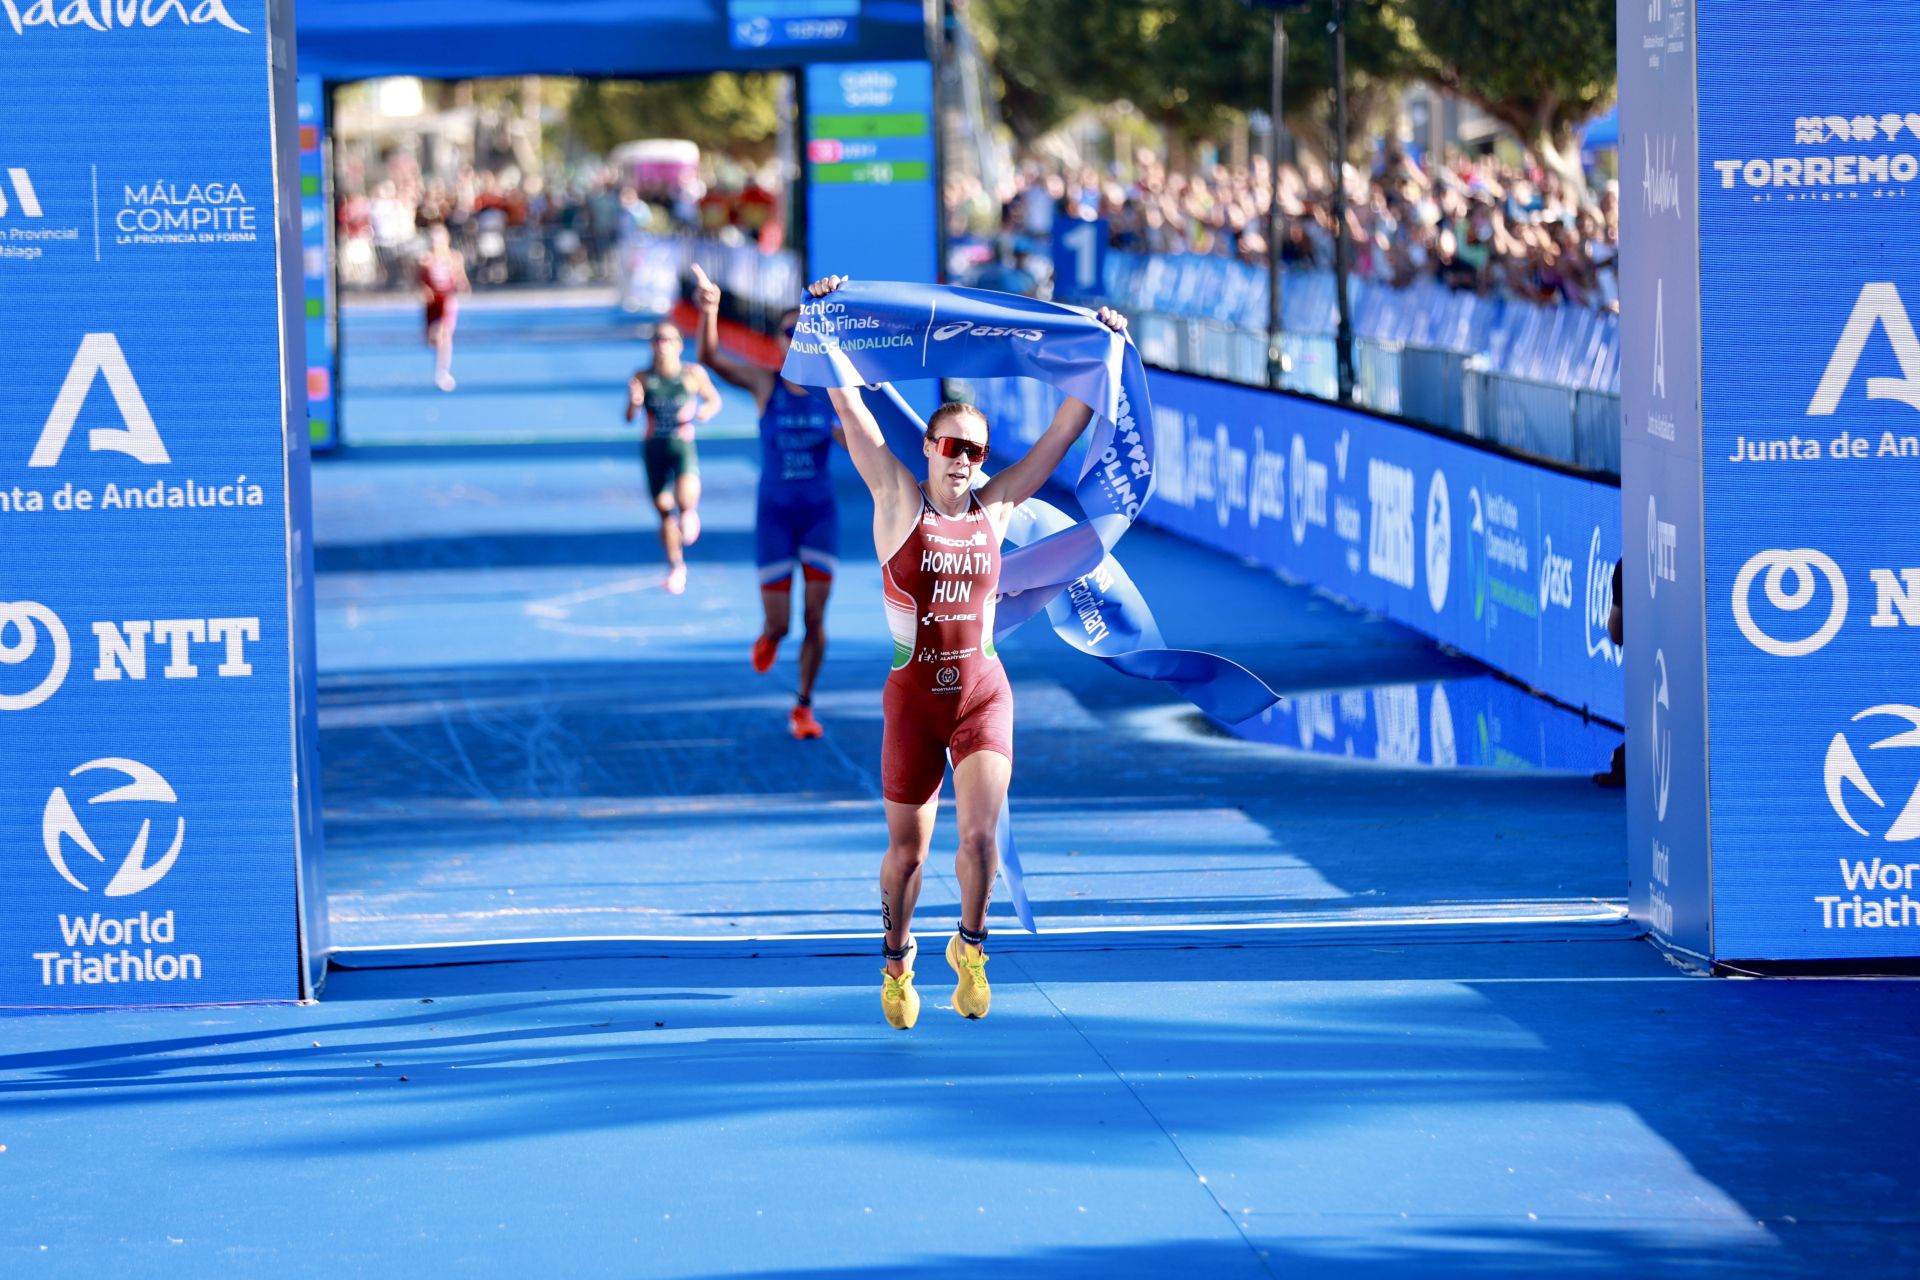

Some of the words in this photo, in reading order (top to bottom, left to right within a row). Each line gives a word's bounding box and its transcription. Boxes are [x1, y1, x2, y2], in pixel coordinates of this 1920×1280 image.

[1713, 154, 1919, 189] TORREMO
[124, 179, 247, 206] MÁLAGA
[9, 227, 79, 240] Provincial
[116, 206, 256, 232] COMPITE
[116, 234, 132, 244] LA
[134, 233, 197, 244] PROVINCIA
[836, 316, 880, 331] Finals
[970, 325, 1046, 342] asics
[1728, 436, 1821, 462] Junta
[1829, 431, 1870, 459] de
[1877, 431, 1920, 458] An
[0, 486, 44, 512] nta
[52, 482, 93, 511] de
[101, 474, 264, 510] Andalucía
[920, 548, 991, 575] HORVÁTH
[931, 580, 973, 603] HUN
[934, 613, 977, 622] CUBE
[1067, 574, 1110, 647] traordinary
[92, 617, 260, 681] NTT
[1839, 857, 1920, 891] Wor
[1814, 894, 1920, 929] Triath
[58, 910, 175, 946] World
[33, 949, 202, 986] Triathlon
